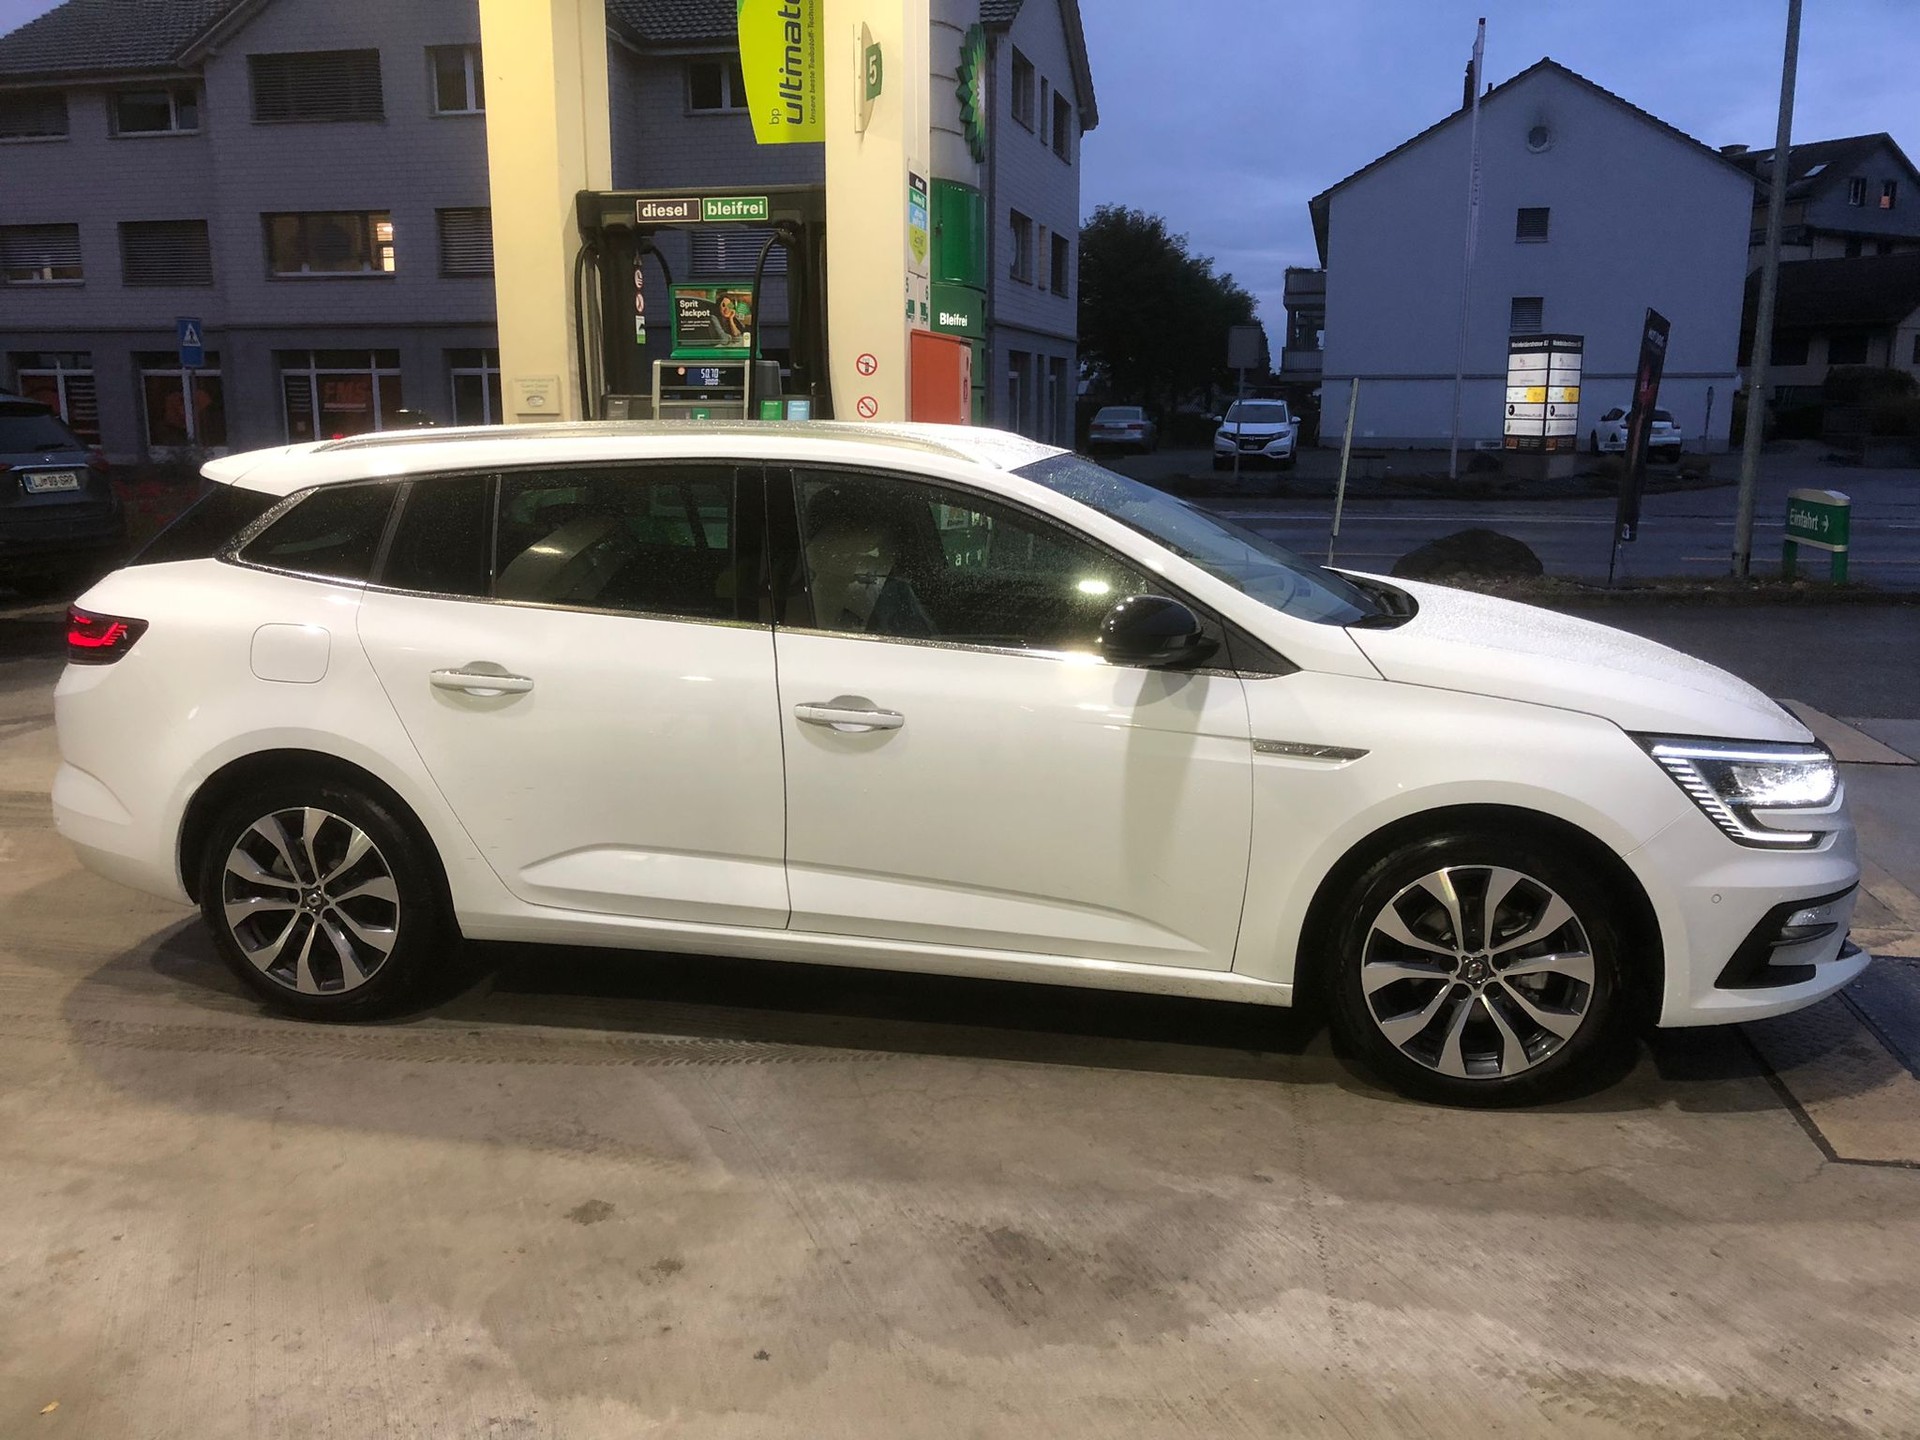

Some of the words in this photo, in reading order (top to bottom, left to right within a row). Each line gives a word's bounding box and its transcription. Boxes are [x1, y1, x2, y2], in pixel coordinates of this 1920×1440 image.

[778, 0, 802, 125] ultimat
[869, 54, 877, 85] 5
[807, 71, 816, 94] beste
[768, 108, 781, 125] bp
[808, 96, 816, 125] Unsere
[641, 202, 688, 217] diesel
[707, 201, 764, 215] bleifrei
[679, 299, 699, 310] Sprit
[680, 309, 711, 319] Jackpot
[939, 312, 968, 327] Bleifrei
[1789, 507, 1819, 531] Einfahrt
